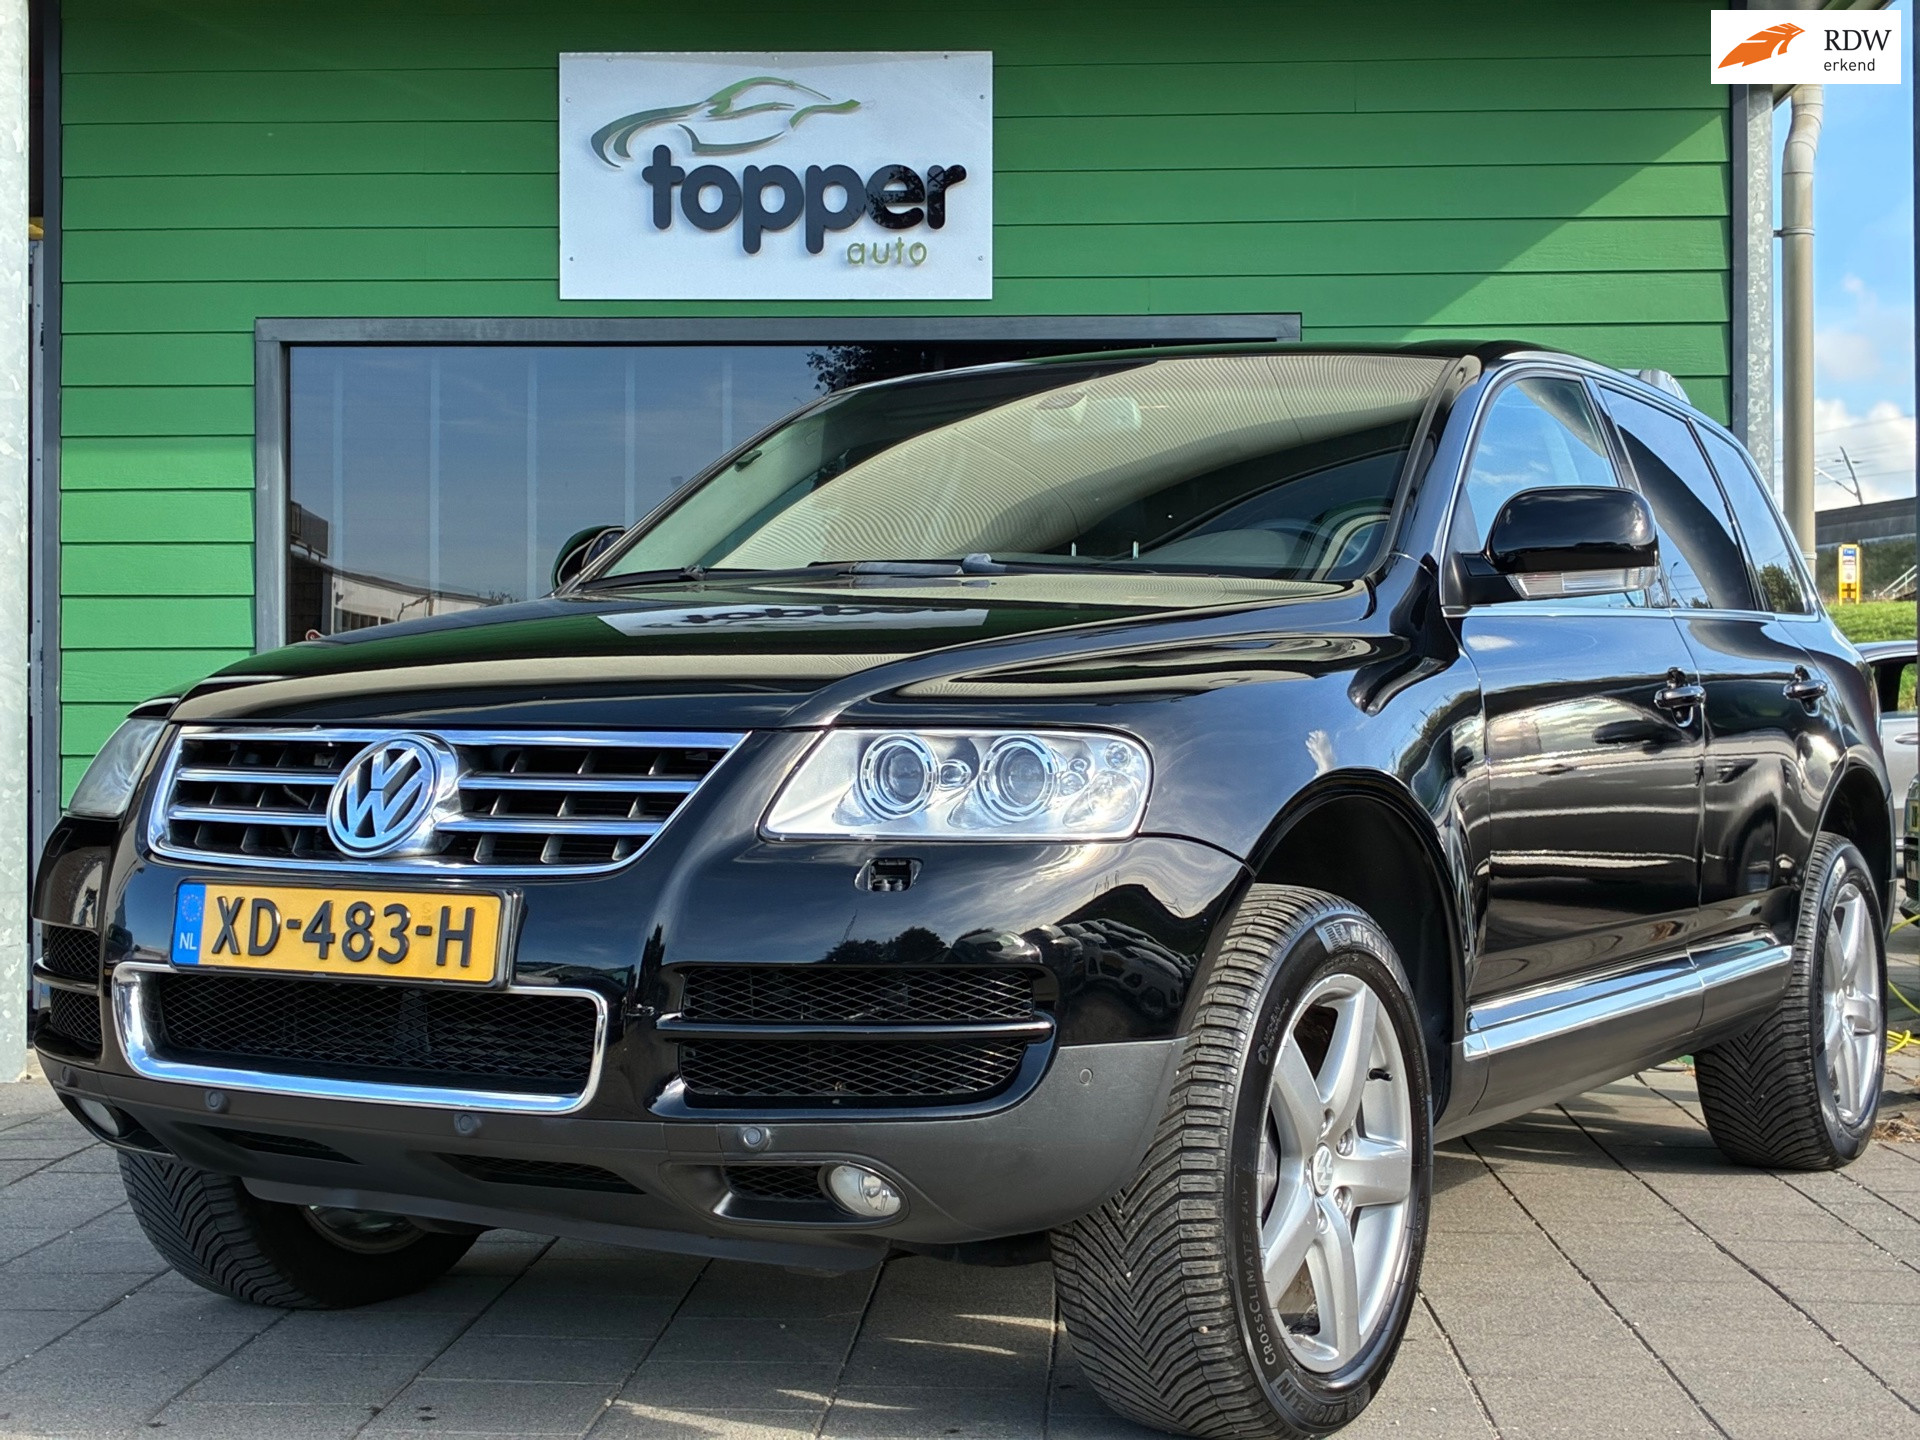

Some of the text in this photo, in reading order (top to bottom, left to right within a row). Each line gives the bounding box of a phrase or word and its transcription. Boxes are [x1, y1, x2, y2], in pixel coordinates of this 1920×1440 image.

[641, 144, 967, 255] topper
[846, 236, 928, 266] auto
[179, 932, 197, 951] NL
[211, 895, 476, 968] XD-483-H
[1242, 1232, 1277, 1366] CROSSCLIMATE
